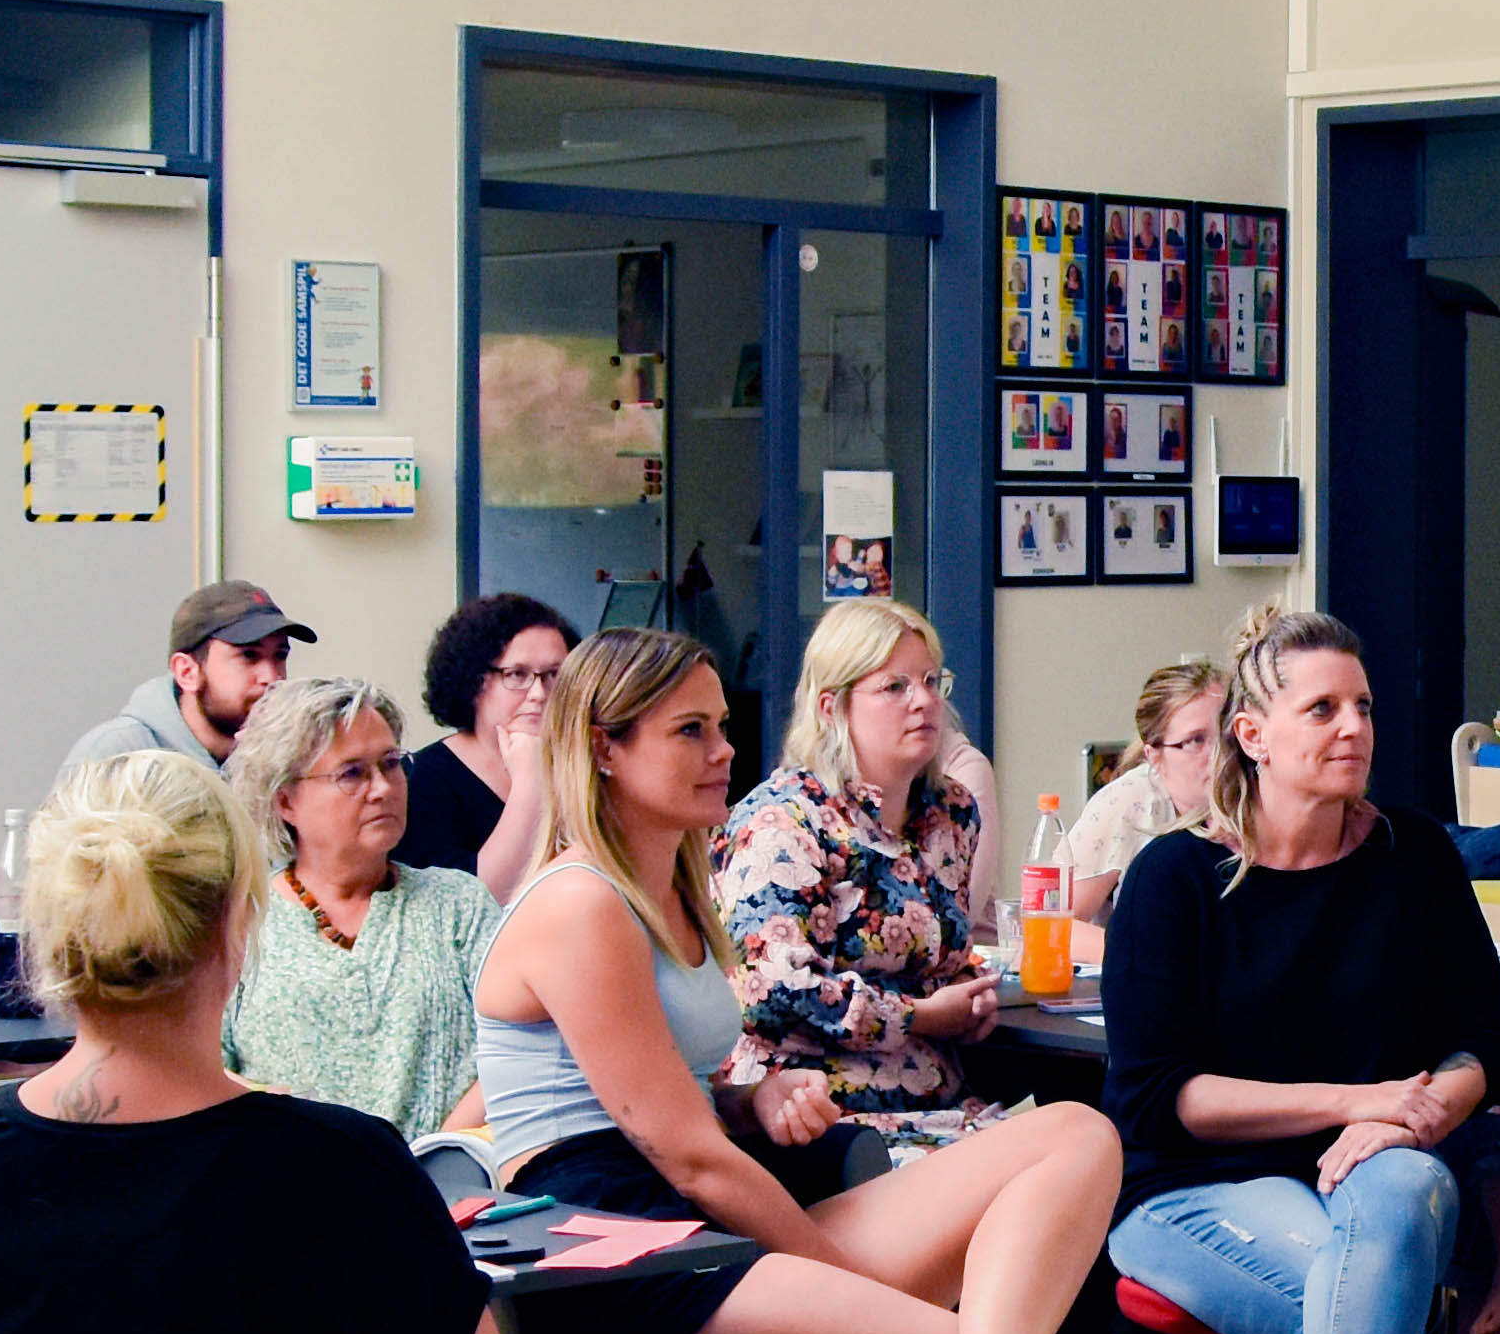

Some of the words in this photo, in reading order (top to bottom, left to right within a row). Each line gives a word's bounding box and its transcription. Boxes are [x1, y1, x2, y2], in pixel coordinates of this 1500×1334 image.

[297, 266, 308, 319] SAMSPIL
[1041, 276, 1050, 339] TEAM
[1139, 282, 1149, 344] TEAM
[297, 322, 308, 358] GODE
[1236, 293, 1245, 353] TEAM
[297, 361, 308, 385] DET
